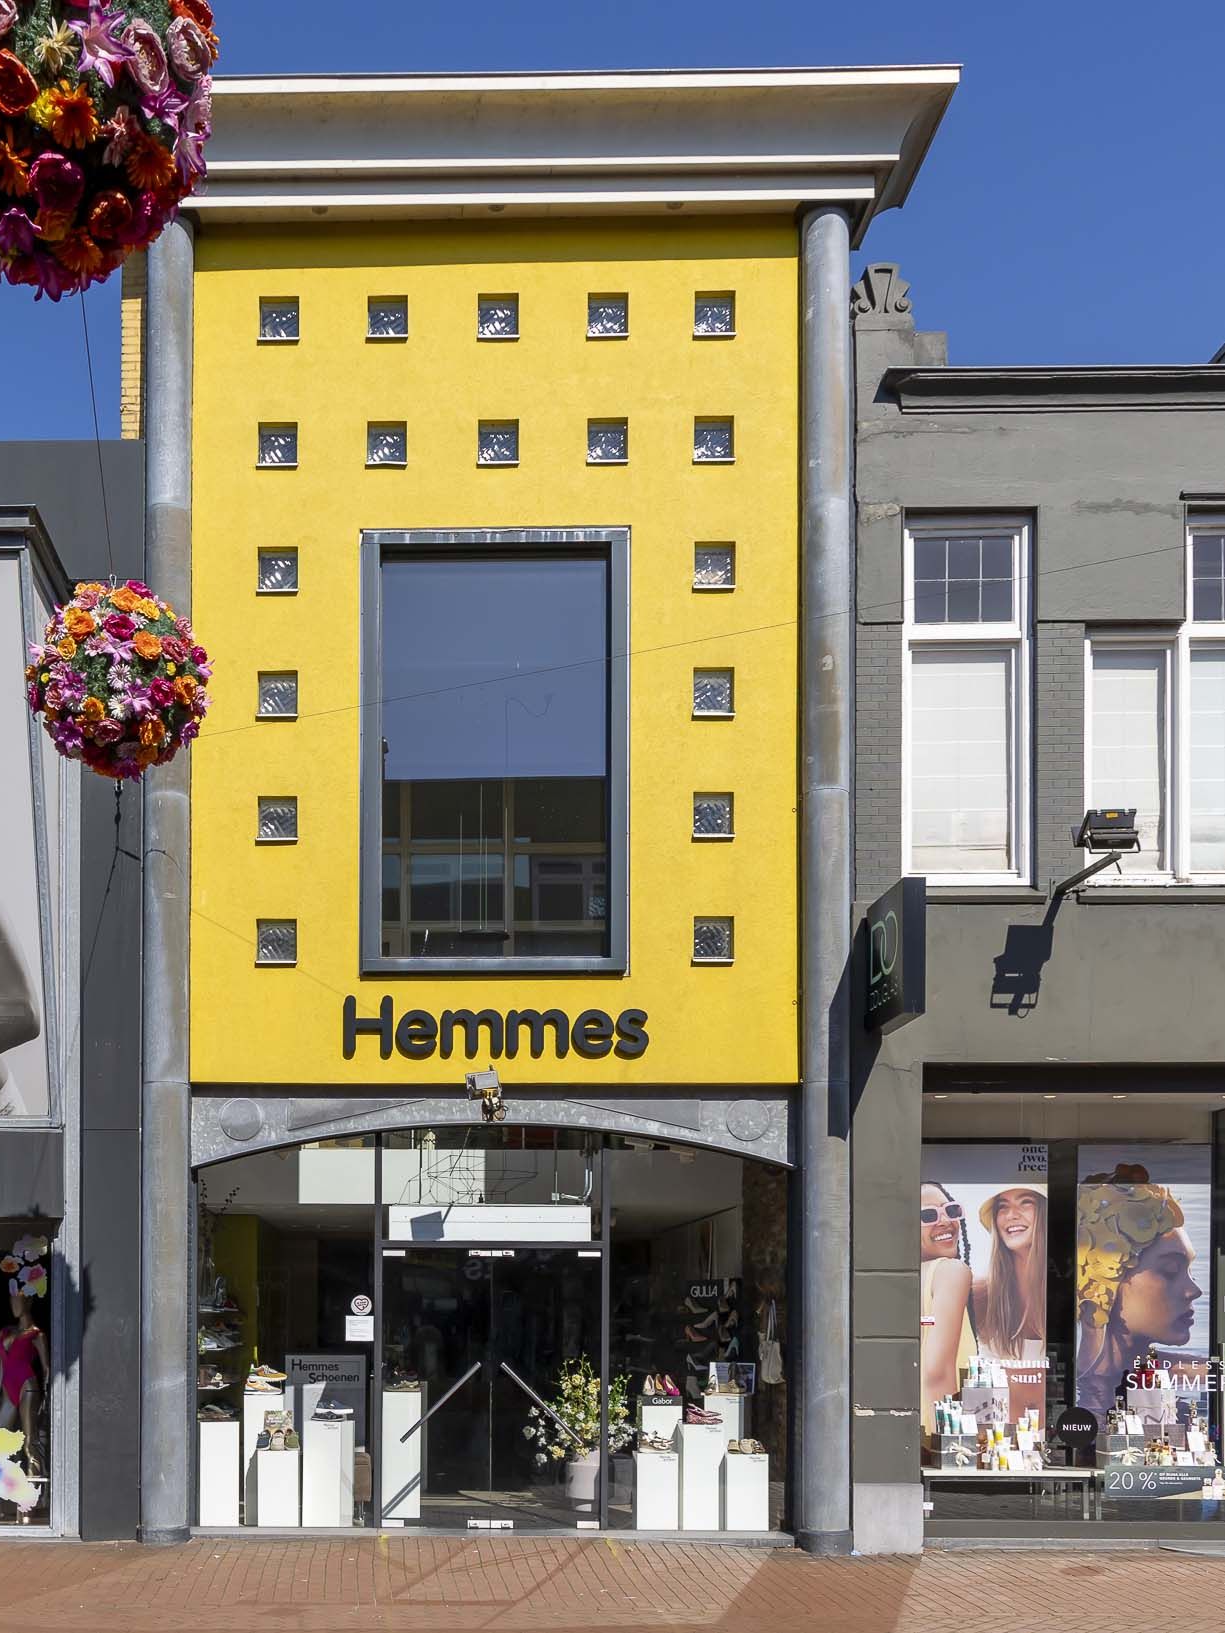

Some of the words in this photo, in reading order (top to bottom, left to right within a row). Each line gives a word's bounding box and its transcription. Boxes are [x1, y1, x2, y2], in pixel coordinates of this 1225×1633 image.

[342, 995, 649, 1060] Hemmes
[291, 1359, 339, 1371] Hemmes
[308, 1373, 359, 1384] Schoenen
[1010, 1373, 1042, 1384] sun!
[1109, 1472, 1133, 1490] 20
